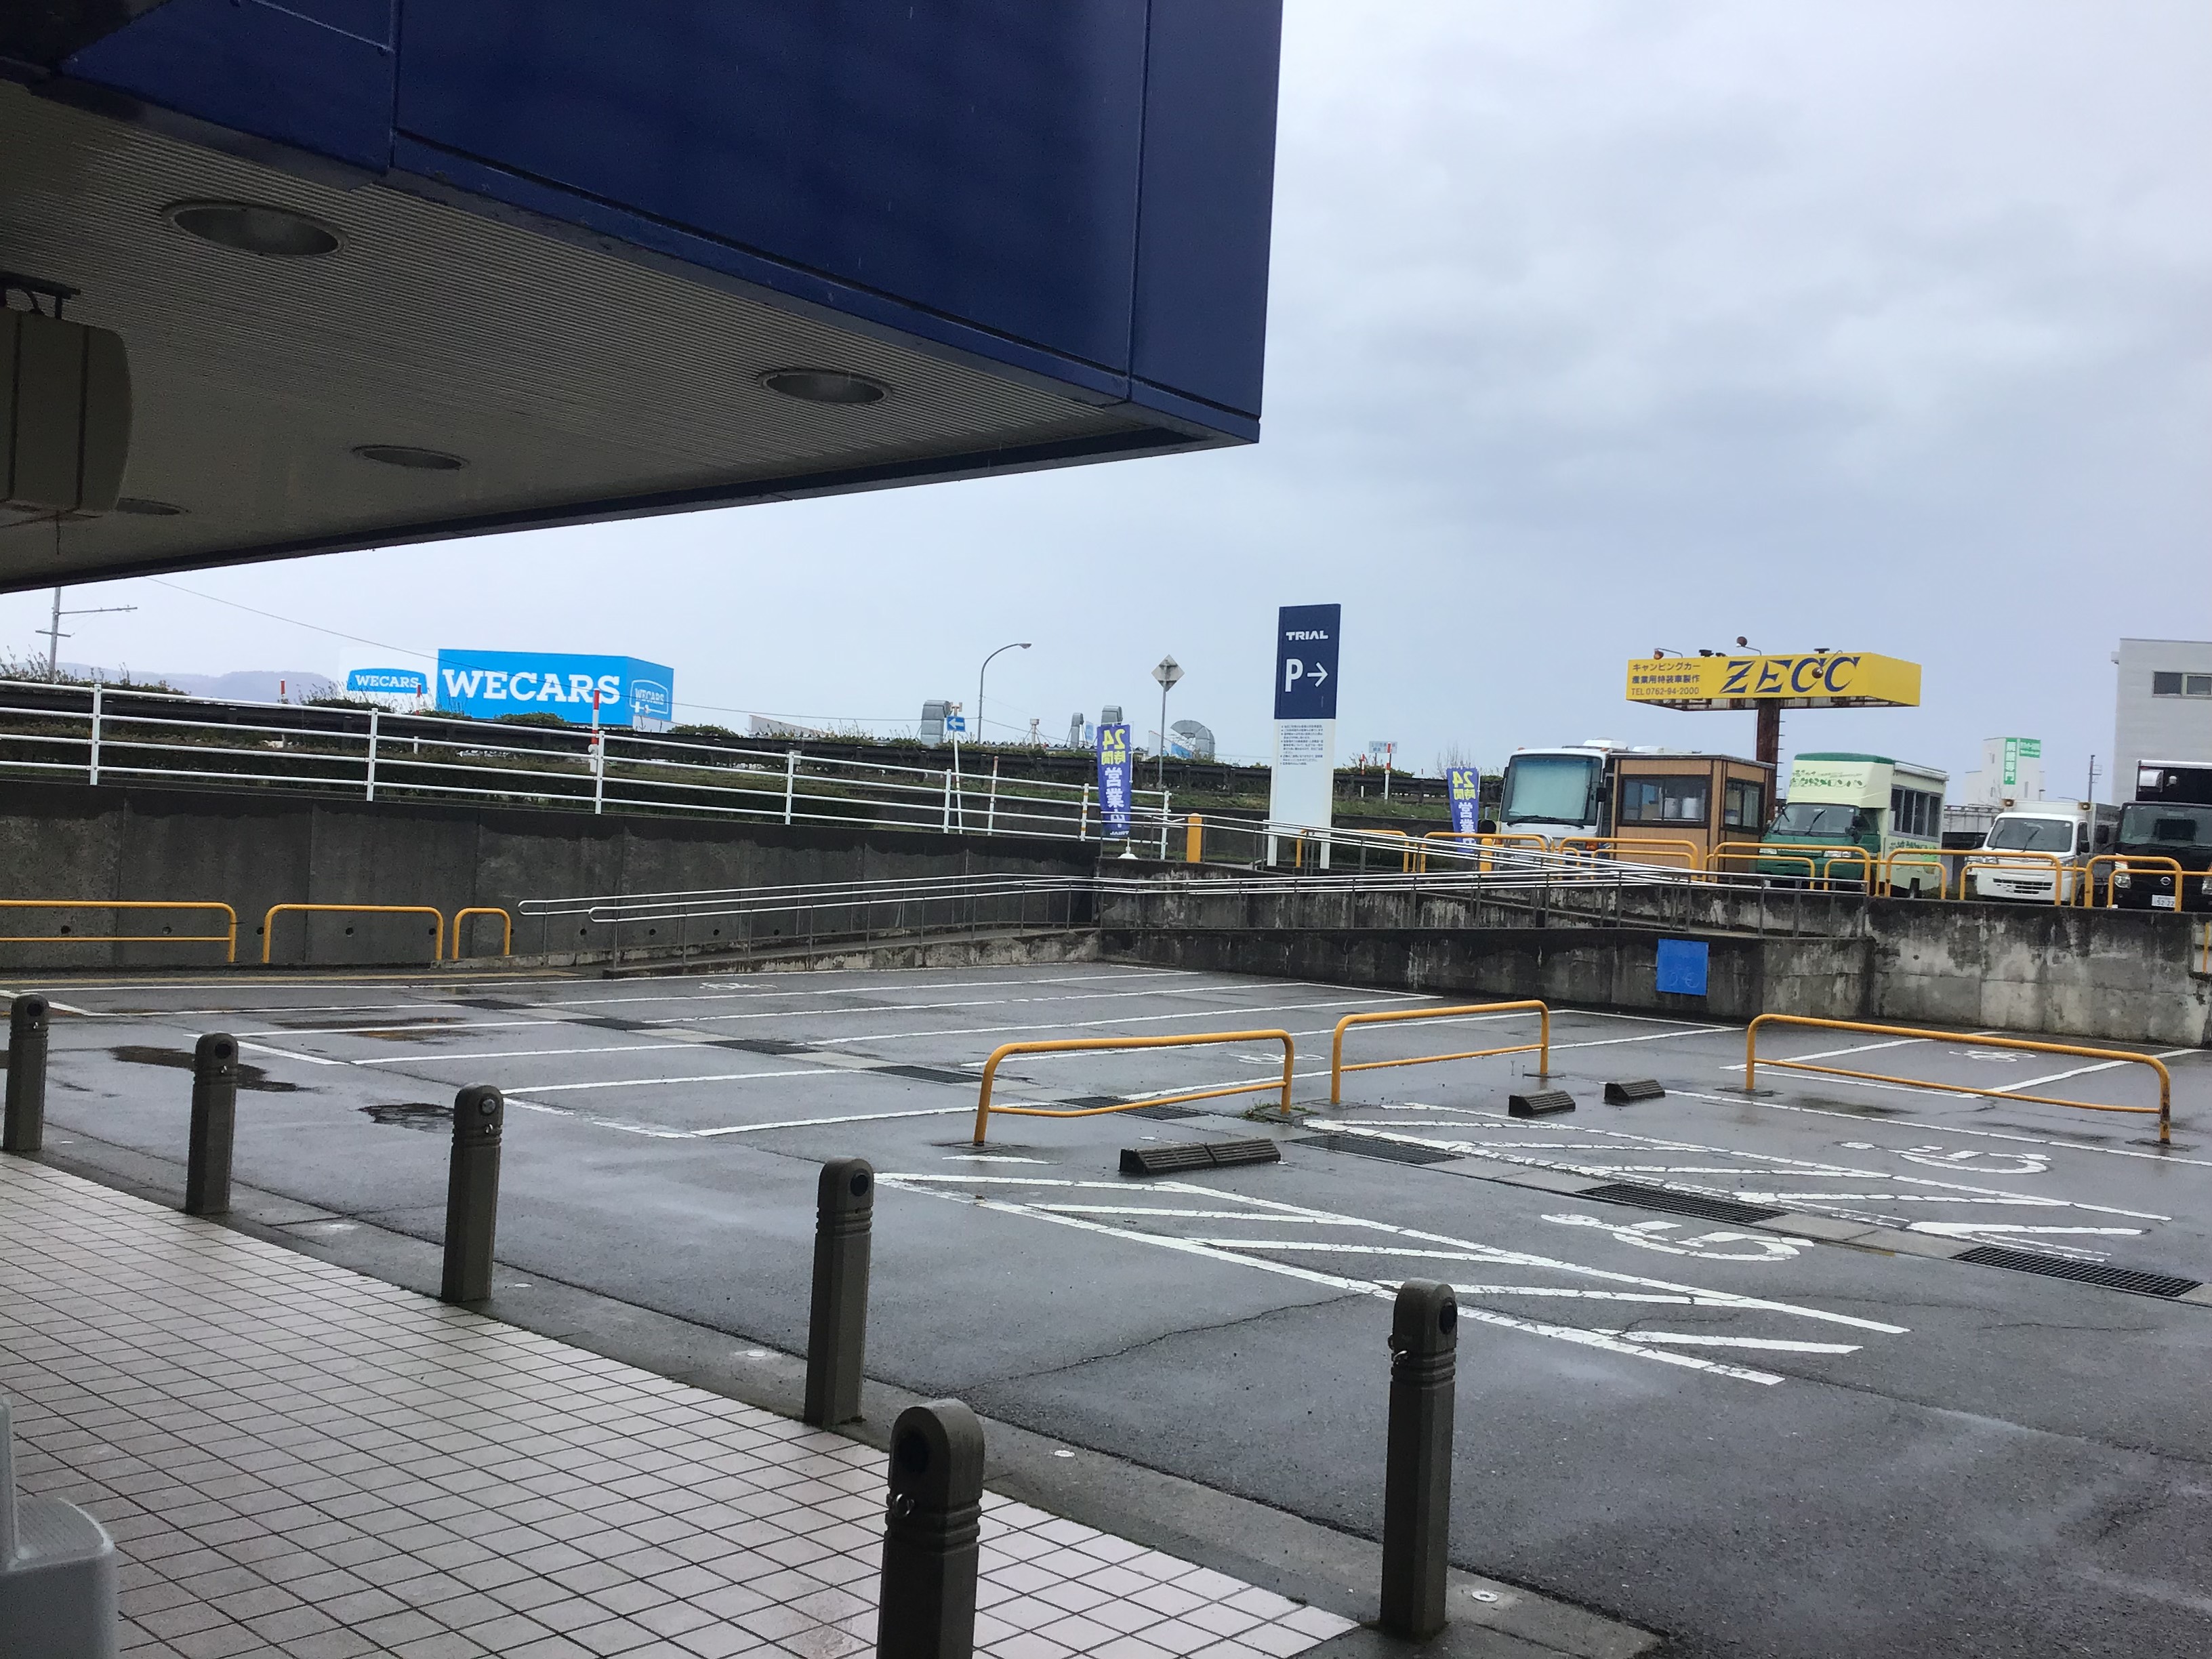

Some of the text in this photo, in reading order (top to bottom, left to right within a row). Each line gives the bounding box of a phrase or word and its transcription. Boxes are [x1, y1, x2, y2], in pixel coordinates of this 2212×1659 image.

[1285, 630, 1328, 640] TRIAL
[1285, 659, 1303, 692] P
[1633, 662, 1700, 672] キャンピングカー
[1719, 656, 1862, 693] ZECC
[355, 674, 419, 688] WECARS
[442, 669, 620, 704] WECARS
